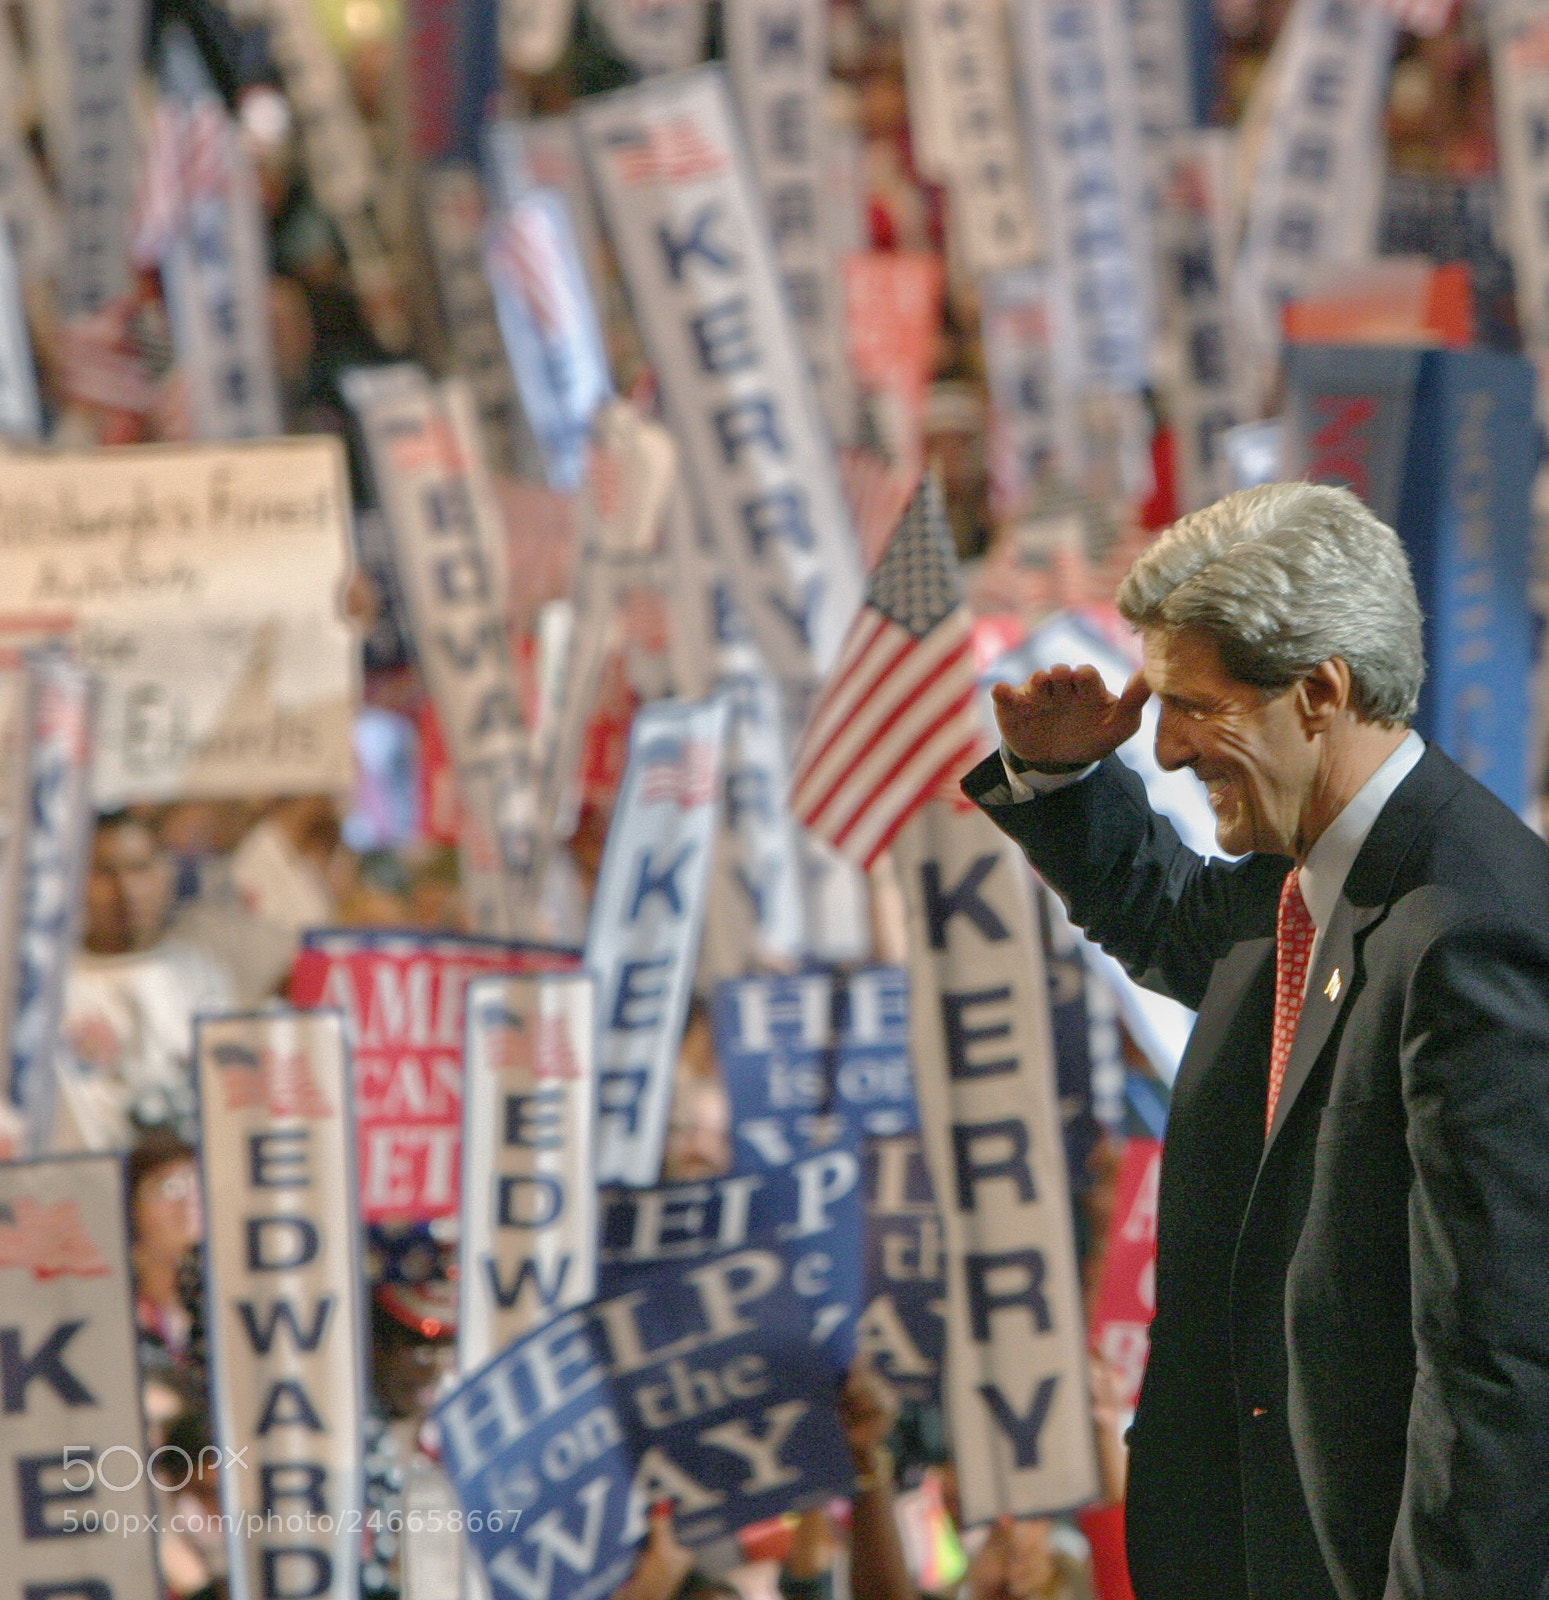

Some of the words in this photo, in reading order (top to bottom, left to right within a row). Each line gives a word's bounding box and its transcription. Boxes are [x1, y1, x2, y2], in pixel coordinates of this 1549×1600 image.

[656, 203, 826, 648] KERRY
[483, 1087, 573, 1310] EDW
[598, 1150, 861, 1264] ELP
[921, 853, 1060, 1471] KERRY
[0, 1318, 116, 1600] KE
[231, 1128, 338, 1600] EDWARD
[436, 1248, 784, 1480] HELP
[540, 1402, 622, 1483] on
[636, 1352, 772, 1432] the
[488, 1400, 812, 1600] WAY
